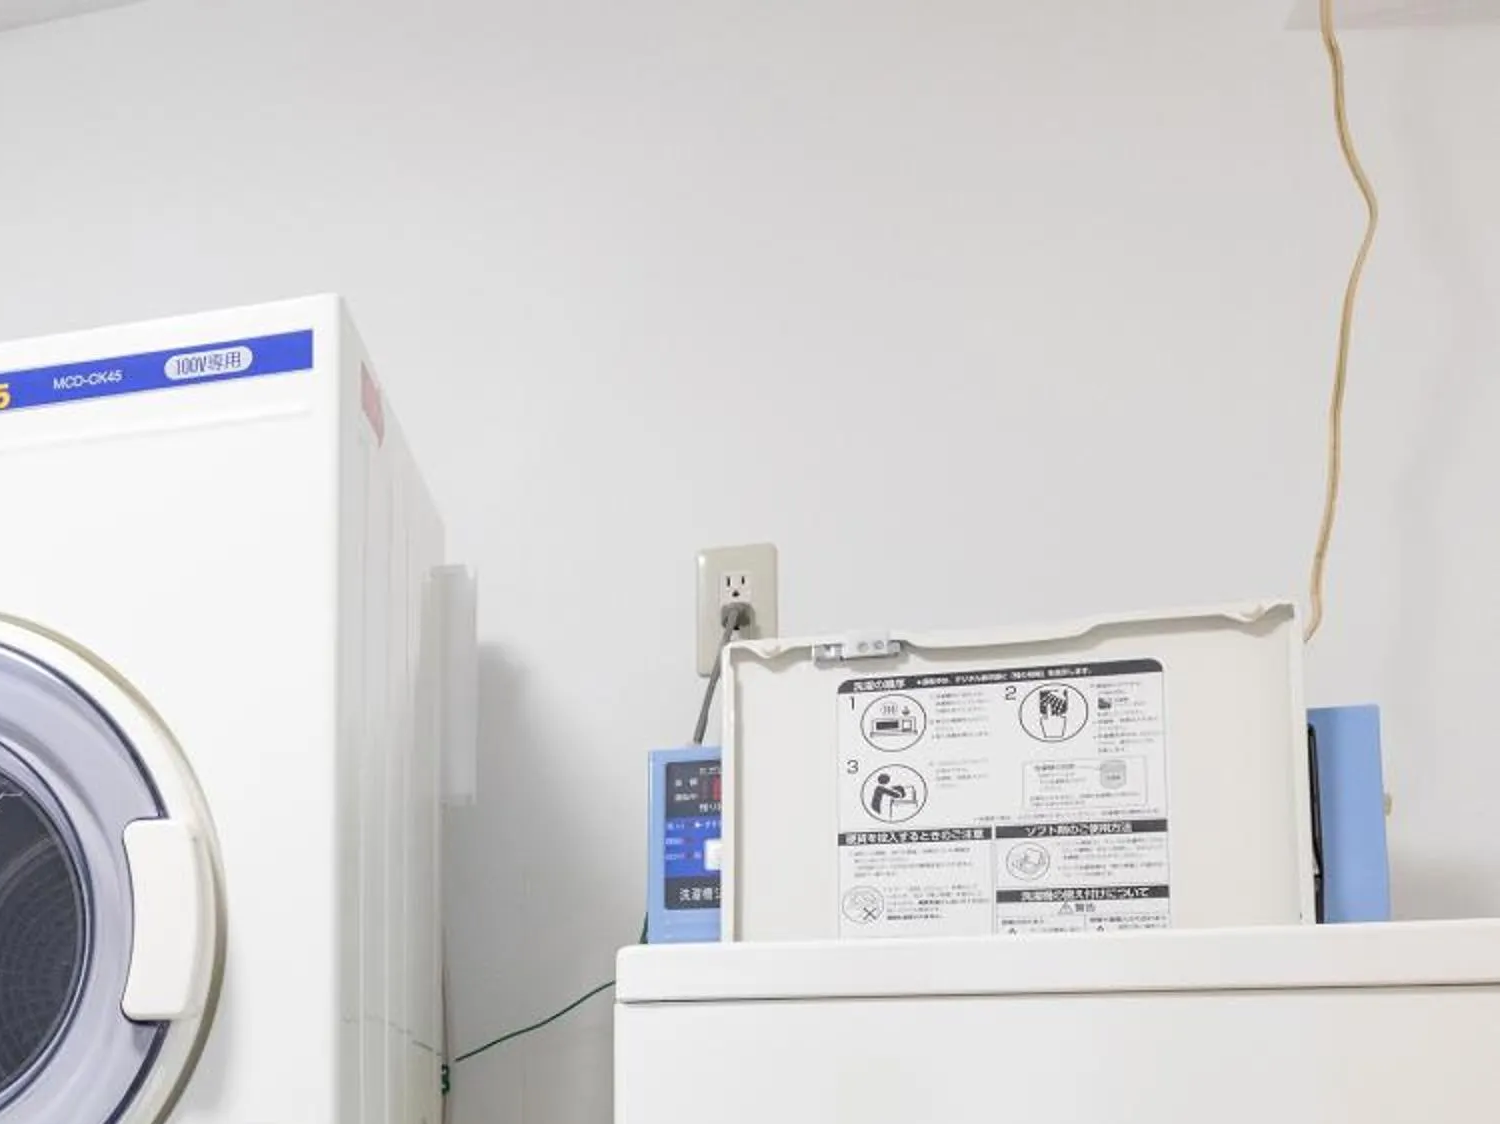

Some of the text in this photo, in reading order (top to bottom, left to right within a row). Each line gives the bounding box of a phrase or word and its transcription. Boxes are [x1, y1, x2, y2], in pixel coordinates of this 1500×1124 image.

[176, 351, 241, 376] 100V専用
[53, 369, 124, 390] MCD-CK45
[1005, 685, 1017, 701] 2
[846, 759, 859, 774] 3
